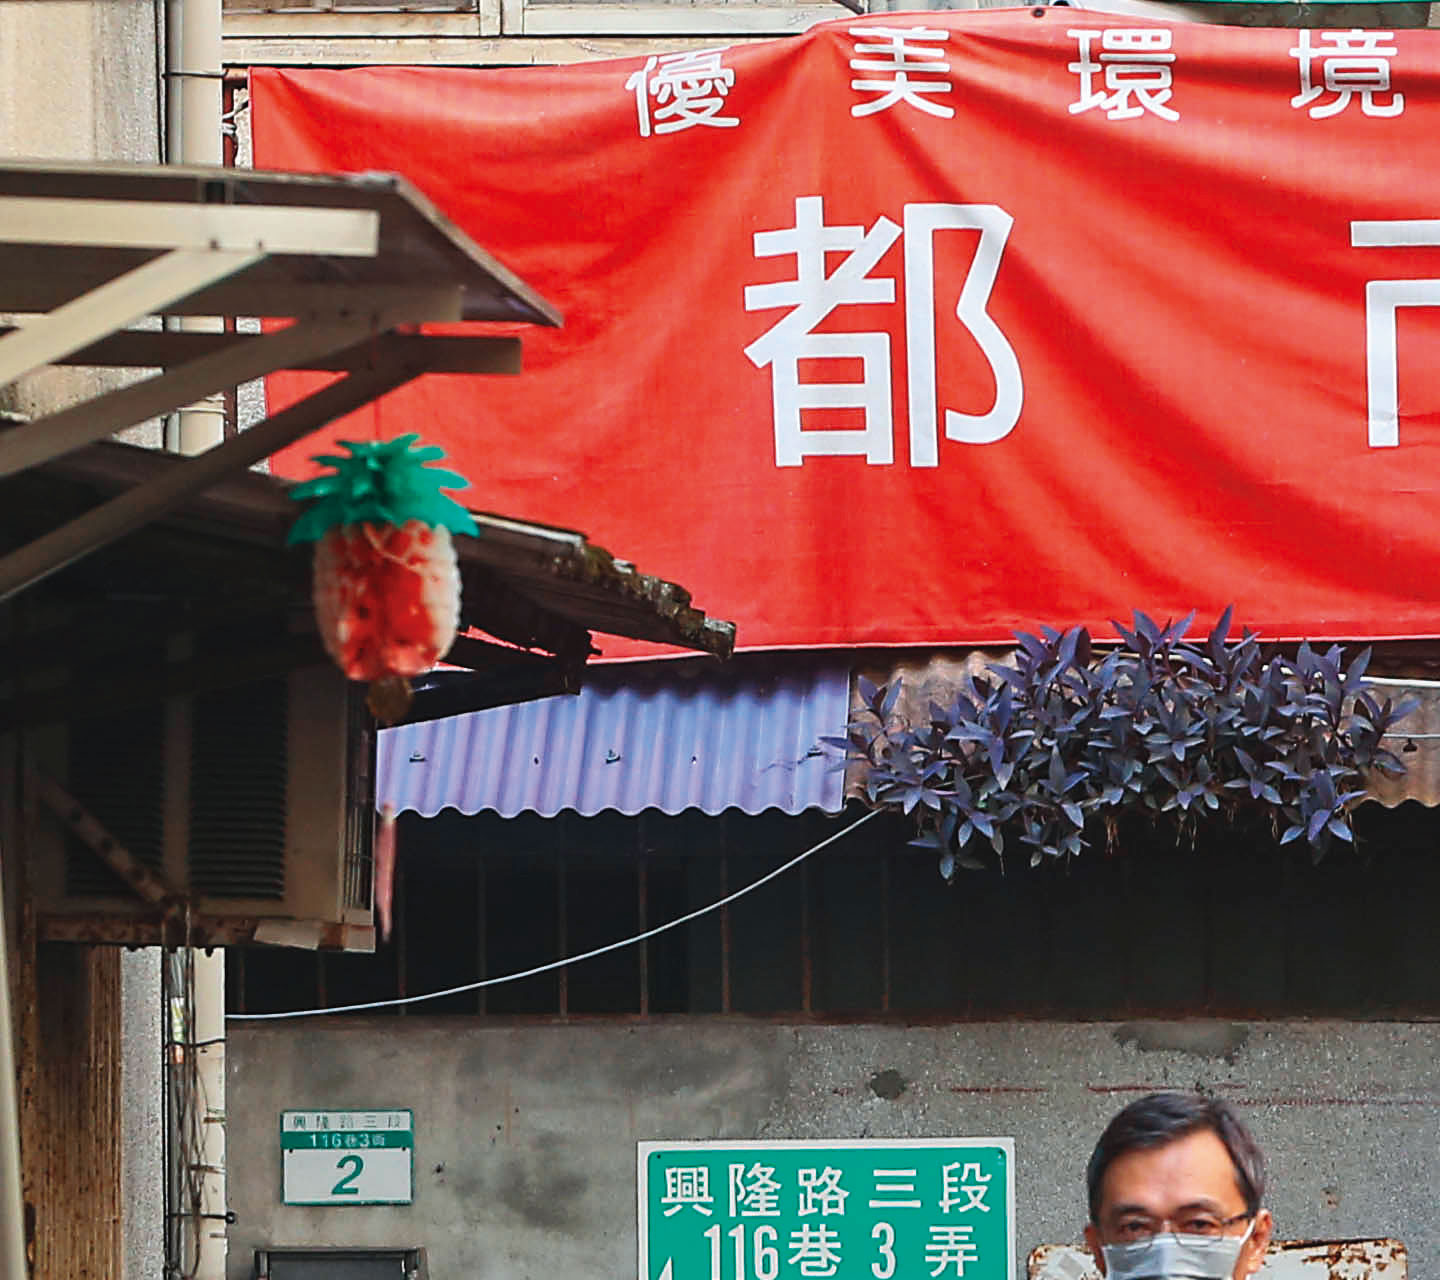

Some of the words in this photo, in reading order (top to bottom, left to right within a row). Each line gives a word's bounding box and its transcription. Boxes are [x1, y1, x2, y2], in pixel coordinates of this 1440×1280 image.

[331, 1154, 365, 1196] 2
[660, 1161, 993, 1218] 興隆路三段
